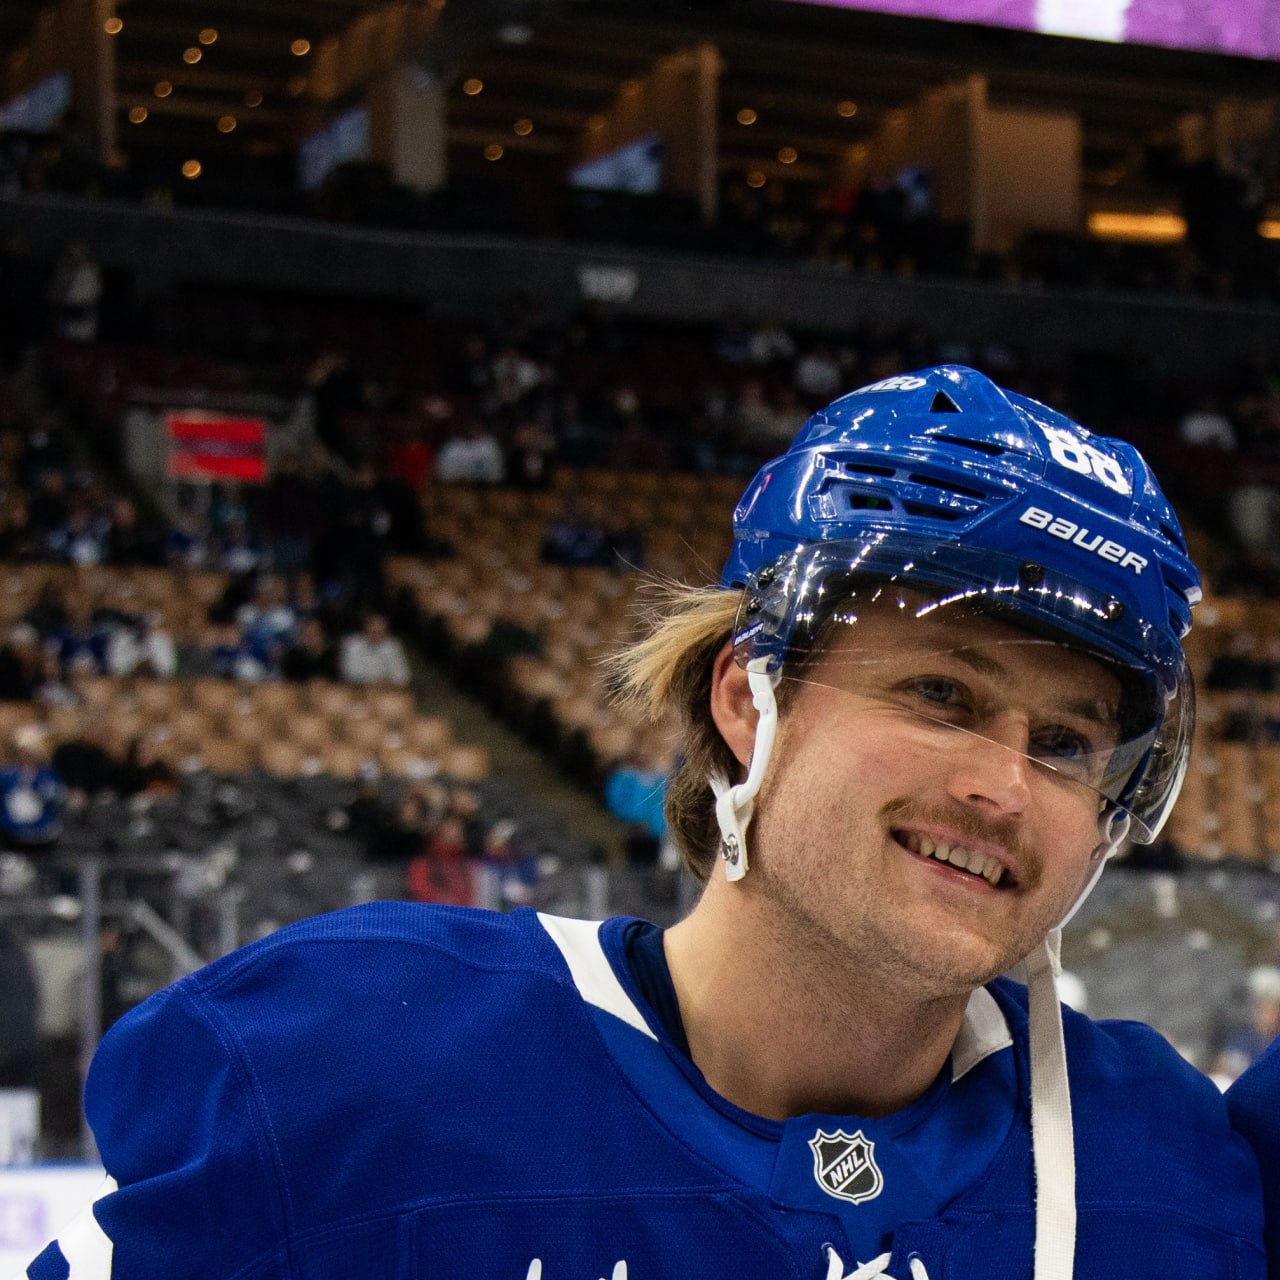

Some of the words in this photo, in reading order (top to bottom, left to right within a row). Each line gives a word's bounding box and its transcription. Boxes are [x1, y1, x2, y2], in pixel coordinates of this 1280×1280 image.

[1043, 425, 1133, 495] 88
[1019, 506, 1148, 574] BAUER
[829, 1150, 864, 1188] NHL
